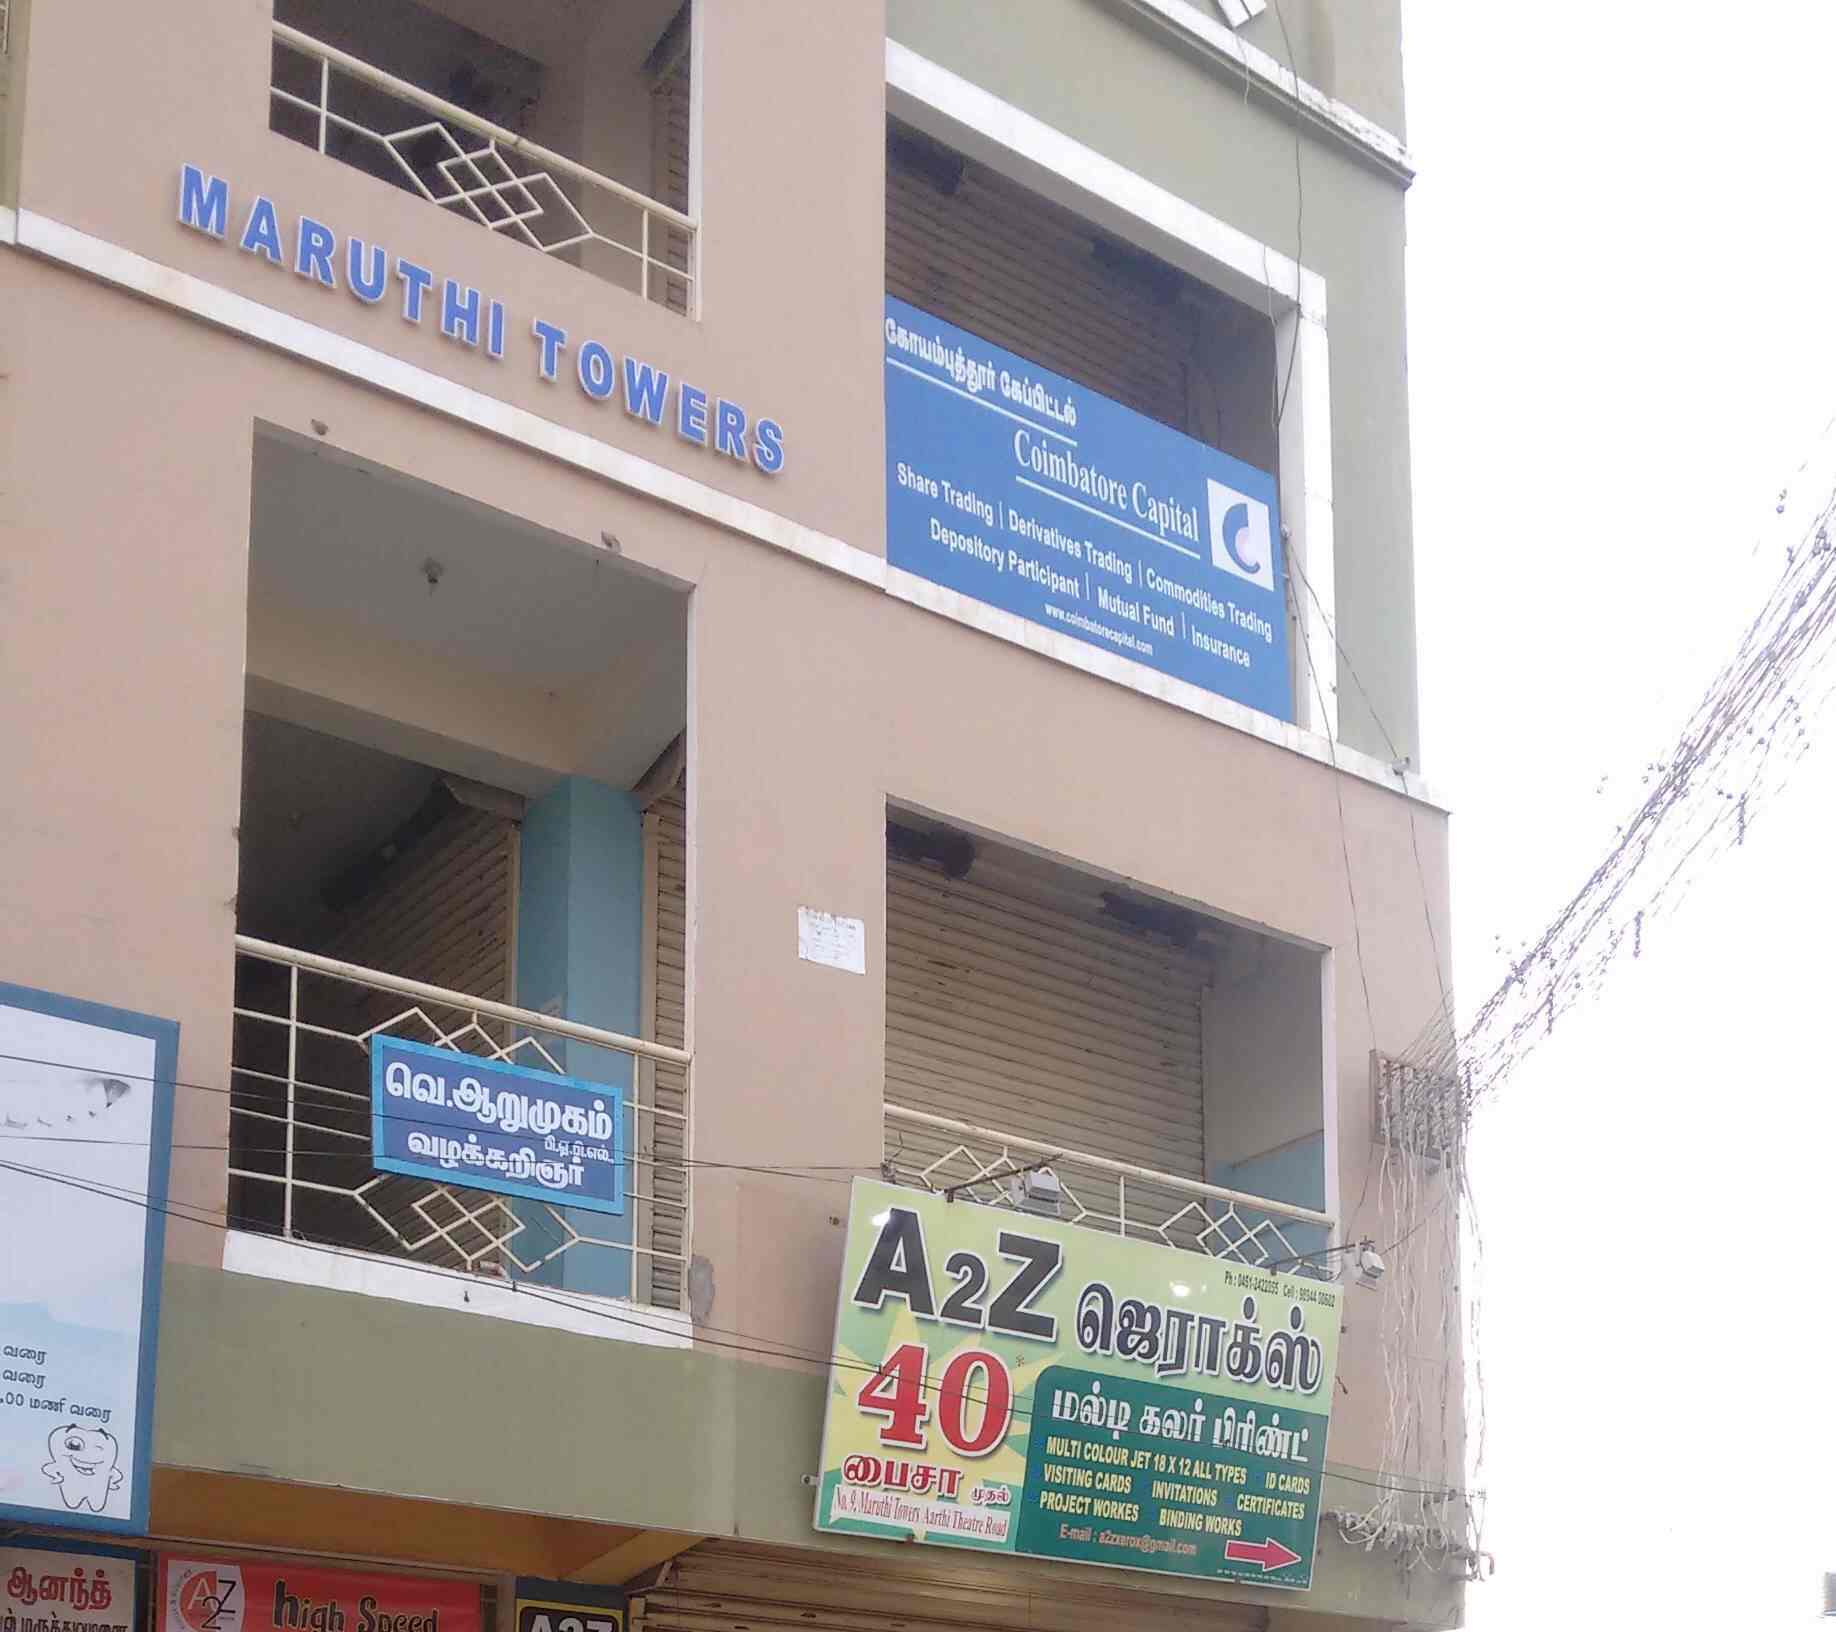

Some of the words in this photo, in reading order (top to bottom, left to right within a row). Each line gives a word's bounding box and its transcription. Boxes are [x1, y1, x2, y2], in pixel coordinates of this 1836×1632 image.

[177, 161, 506, 360] MARUTHI
[531, 316, 786, 476] TOWERS
[897, 462, 938, 498] Share
[942, 481, 993, 527] Trading
[1014, 428, 1127, 510] Coimbatore
[1133, 481, 1200, 543] Capital
[930, 517, 1004, 571] Depository
[1008, 550, 1080, 598] Participant
[1009, 508, 1081, 559] Derivatives
[1085, 540, 1132, 583] Trading
[1098, 586, 1140, 622] Mutual
[1144, 601, 1175, 637] Fund
[1146, 568, 1224, 618] Commodities
[1229, 601, 1272, 643] Trading
[1192, 625, 1250, 667] Insurance
[408, 1133, 585, 1189] வழக்கறிஞர்
[852, 1206, 1065, 1343] A2Z
[3, 1345, 47, 1365] வரை
[1076, 1282, 1324, 1395] ஜெராக்ஸ்
[2, 1369, 46, 1389] வரை
[857, 1342, 1014, 1458] 40
[70, 1404, 112, 1423] வரை
[1051, 1380, 1131, 1441] மல்டி
[1139, 1399, 1206, 1442] கலர்
[1213, 1407, 1309, 1462] பிரிண்ட்
[842, 1454, 963, 1498] பைசா
[971, 1485, 1011, 1505] முதல்
[1044, 1463, 1093, 1488] VISITING
[1096, 1470, 1131, 1494] CARDS
[1046, 1436, 1081, 1459] MULTI
[1083, 1442, 1128, 1467] COLOUR
[1131, 1451, 1151, 1469] JET
[1154, 1454, 1166, 1472] 18
[1178, 1458, 1191, 1476] 12
[1193, 1459, 1212, 1479] ALL
[1215, 1463, 1247, 1485] TYPES
[1265, 1471, 1275, 1489] ID
[1279, 1474, 1310, 1495] CARDS
[1039, 1491, 1090, 1514] PROJECT
[1093, 1499, 1139, 1522] WORKES
[1152, 1480, 1217, 1506] INVITATIONS
[1236, 1494, 1305, 1519] CERTIFICATES
[985, 1516, 1007, 1537] Road
[1160, 1509, 1202, 1531] BINDING
[1205, 1514, 1242, 1537] WORKS
[7, 1566, 113, 1611] ஆனந்த்
